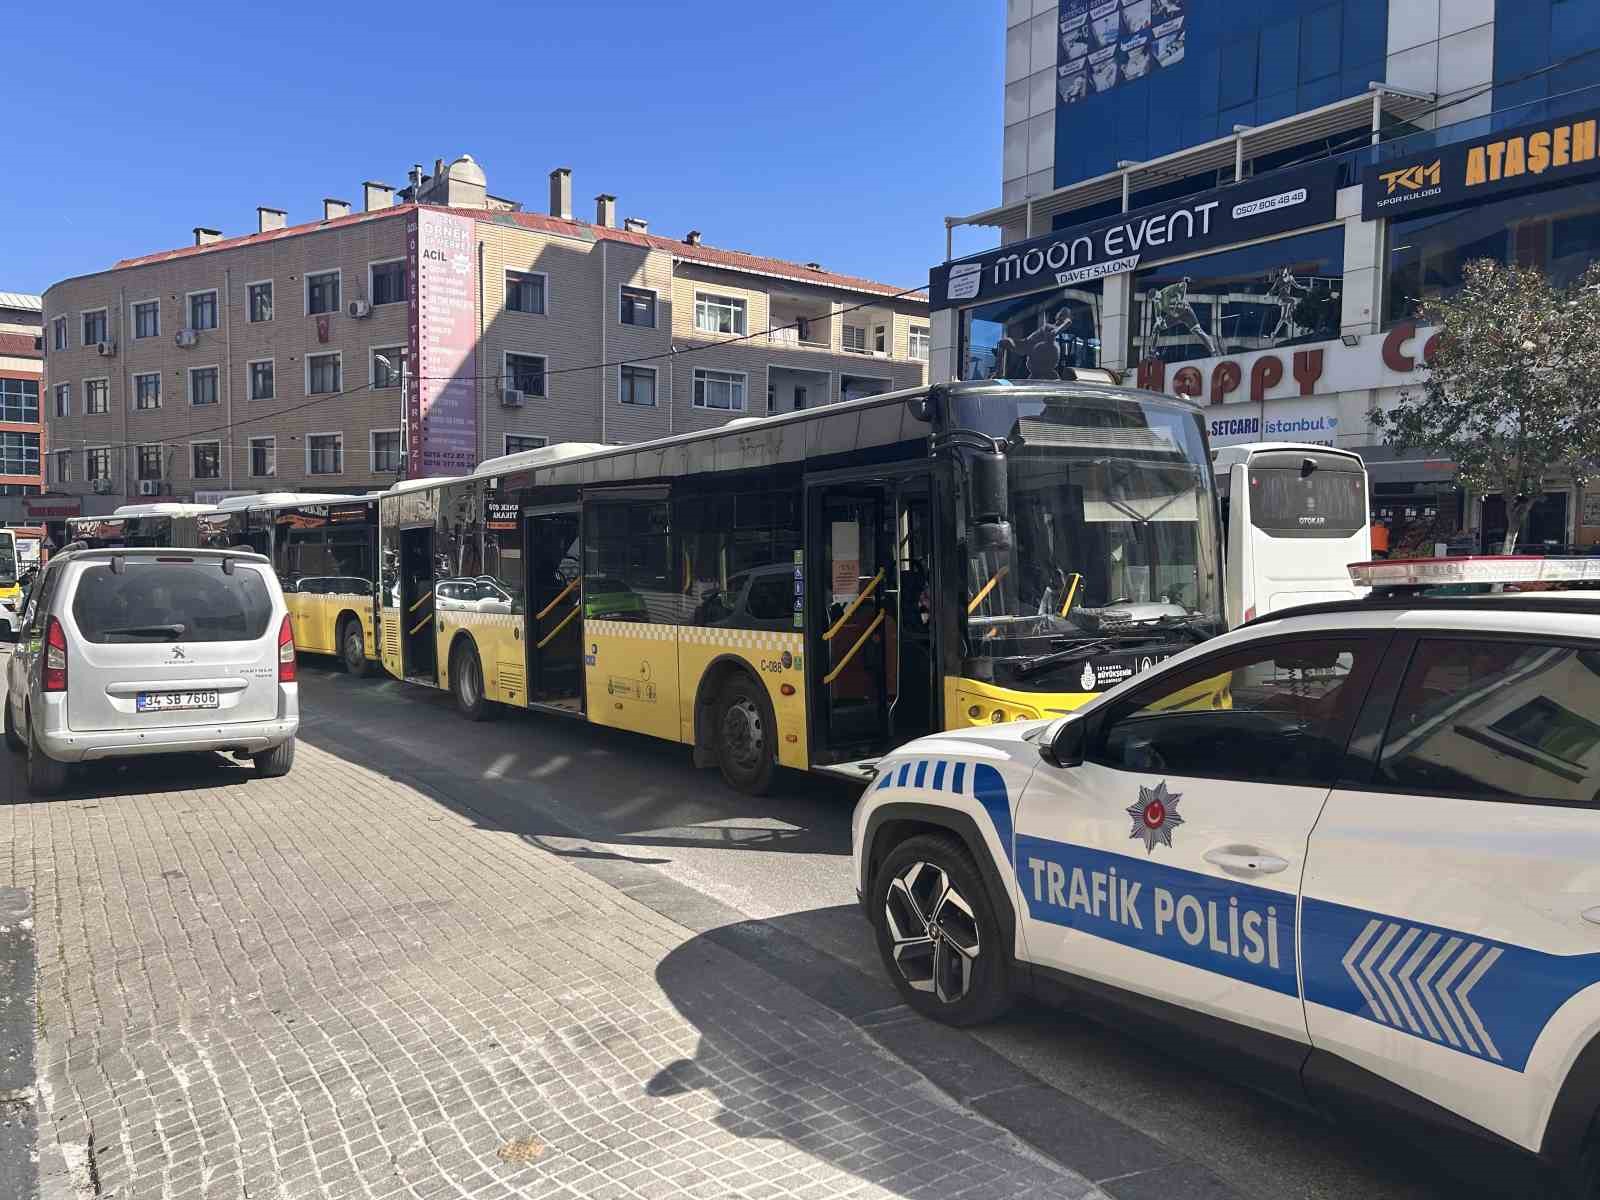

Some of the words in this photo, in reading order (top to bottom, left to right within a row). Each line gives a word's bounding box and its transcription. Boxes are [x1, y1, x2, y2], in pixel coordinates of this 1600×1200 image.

[1465, 120, 1600, 186] ATAŞEH
[1376, 196, 1403, 207] SPOR
[423, 248, 447, 262] ACİL
[1060, 268, 1091, 284] DAVET
[1094, 257, 1136, 277] SALONU
[1212, 418, 1259, 435] SETCARD
[1265, 416, 1326, 433] istanbul
[1299, 517, 1326, 525] OTOKAR
[146, 694, 161, 705] 34
[166, 693, 181, 704] SB
[186, 692, 216, 703] 7606
[1028, 857, 1143, 930] TRAFİK
[1154, 887, 1280, 969] POLİSİ
